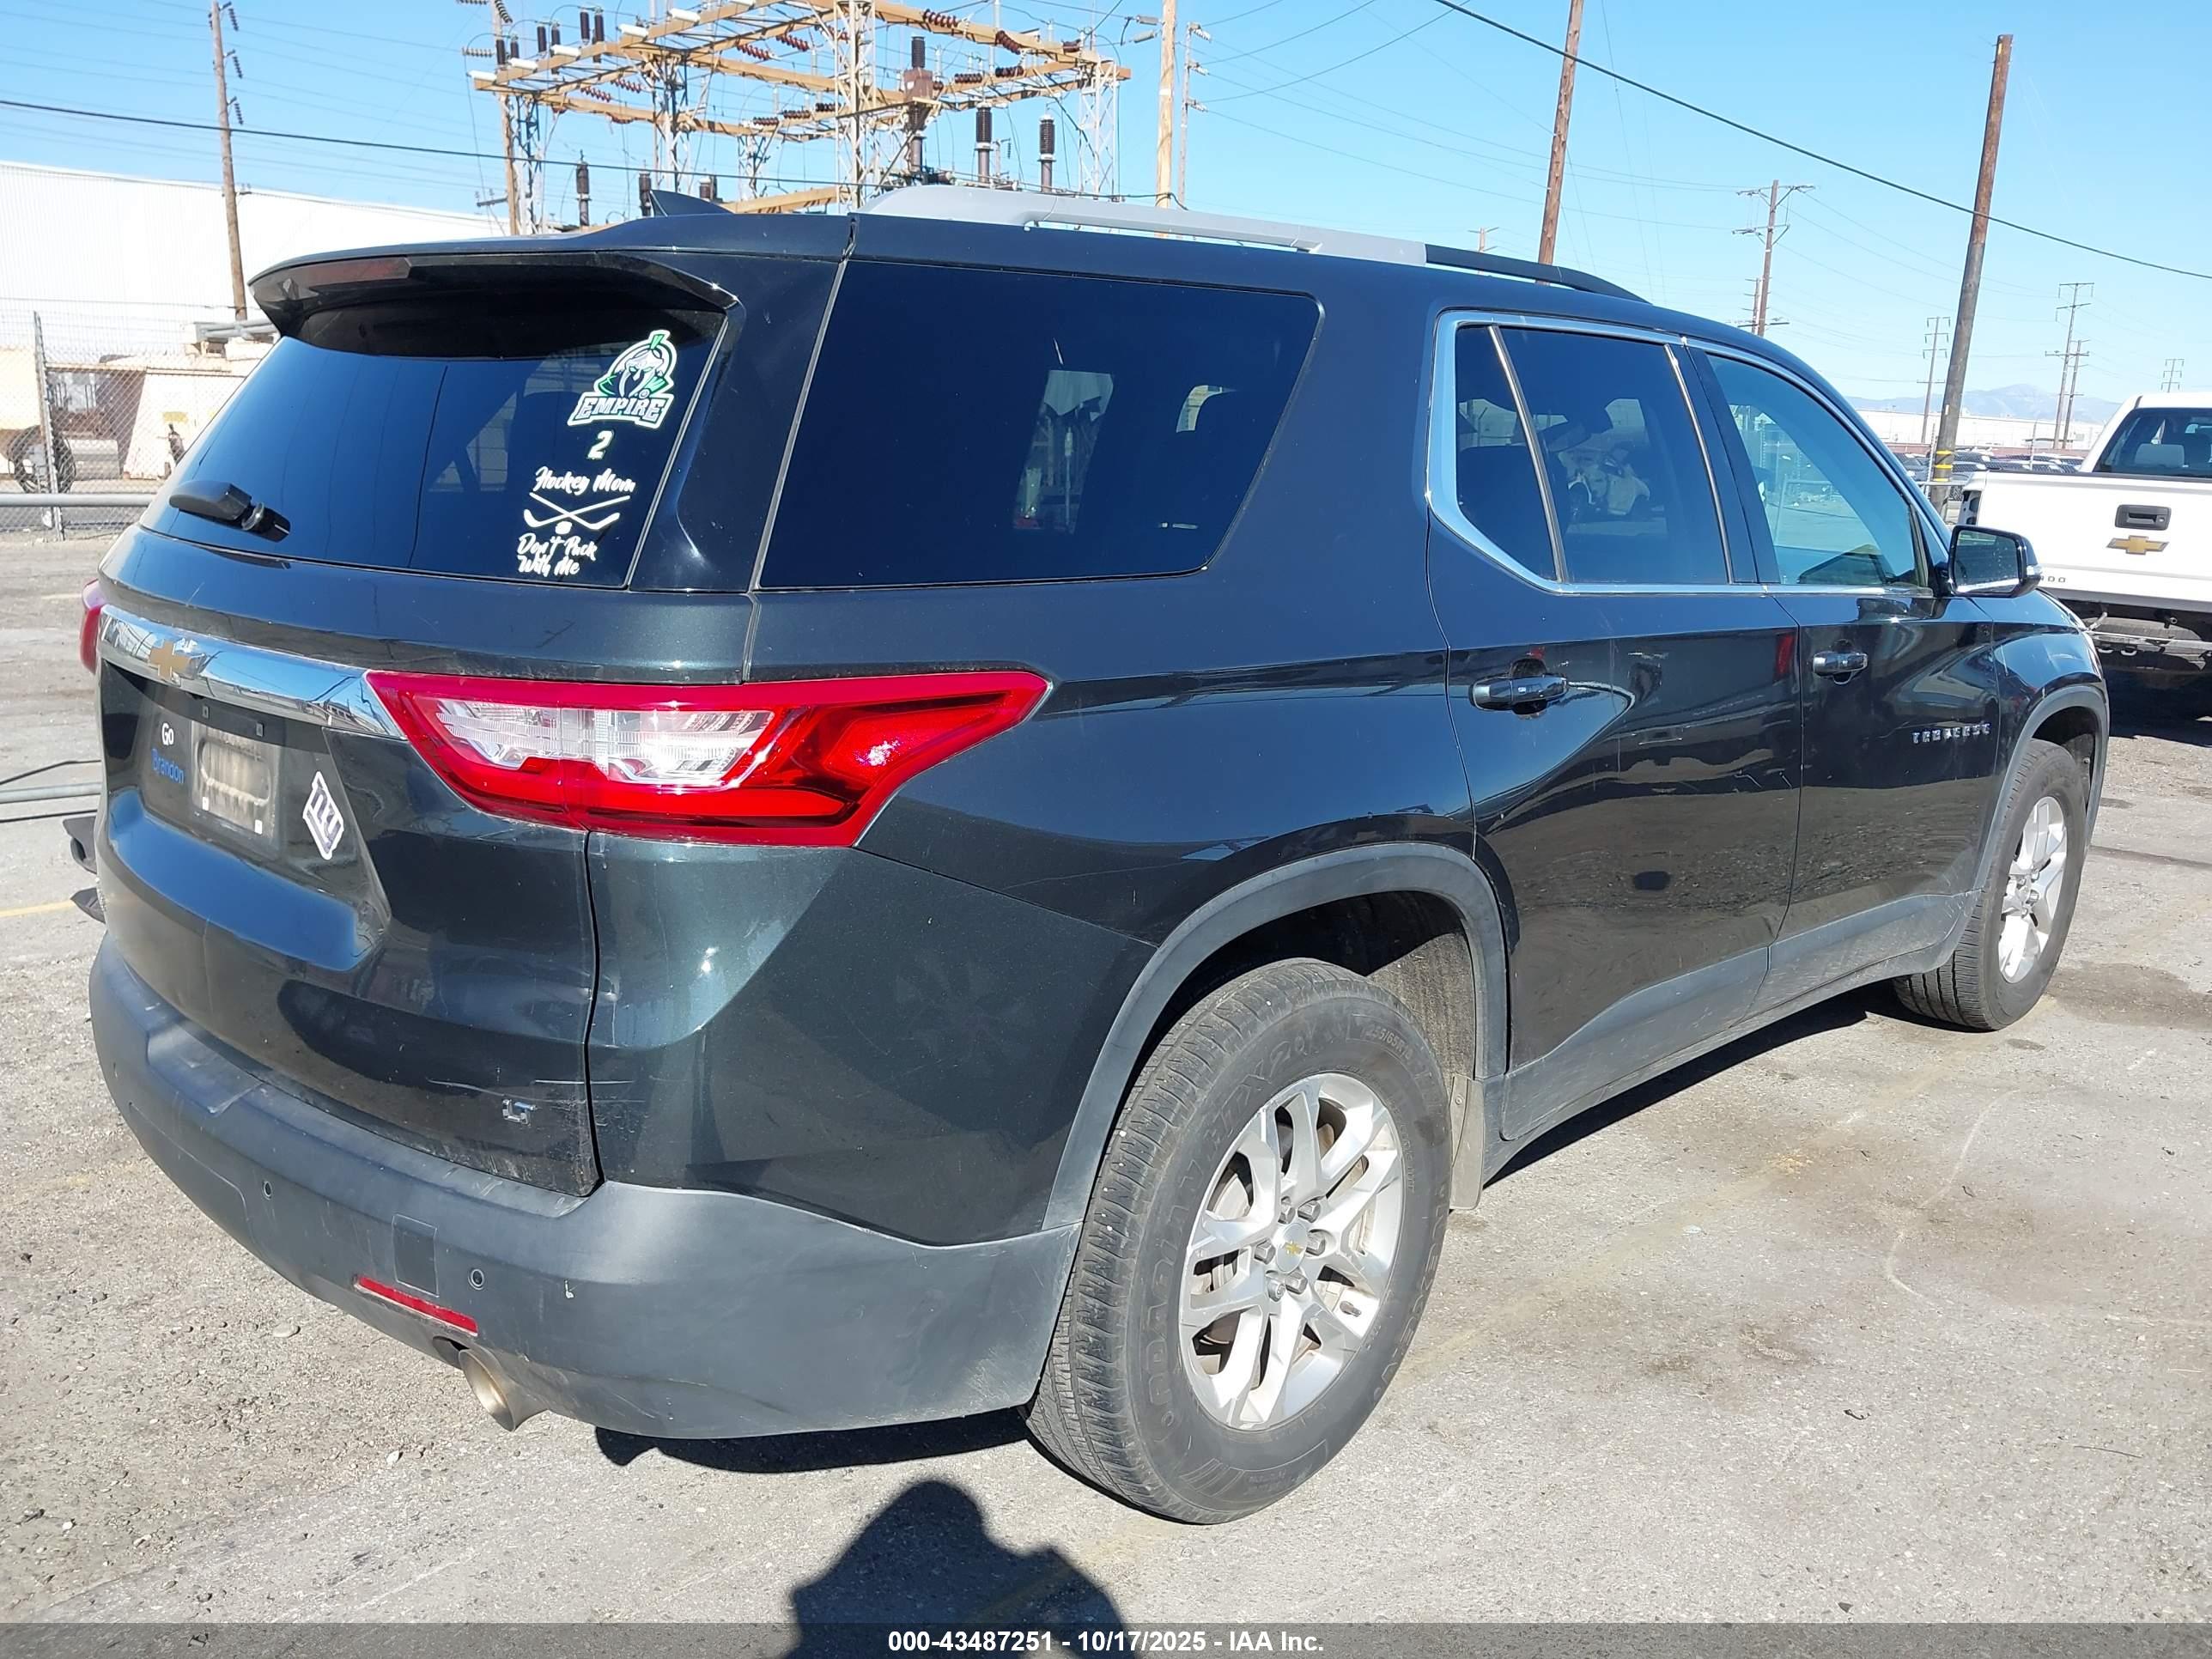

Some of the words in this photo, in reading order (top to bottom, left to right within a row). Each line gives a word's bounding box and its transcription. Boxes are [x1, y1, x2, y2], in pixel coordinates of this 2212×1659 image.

[574, 396, 665, 421] EMPIRE
[587, 431, 612, 459] 2
[534, 467, 590, 495] Hockey
[592, 470, 635, 492] Mom
[554, 557, 580, 575] Me
[161, 723, 174, 745] Go
[151, 749, 185, 783] Brandon
